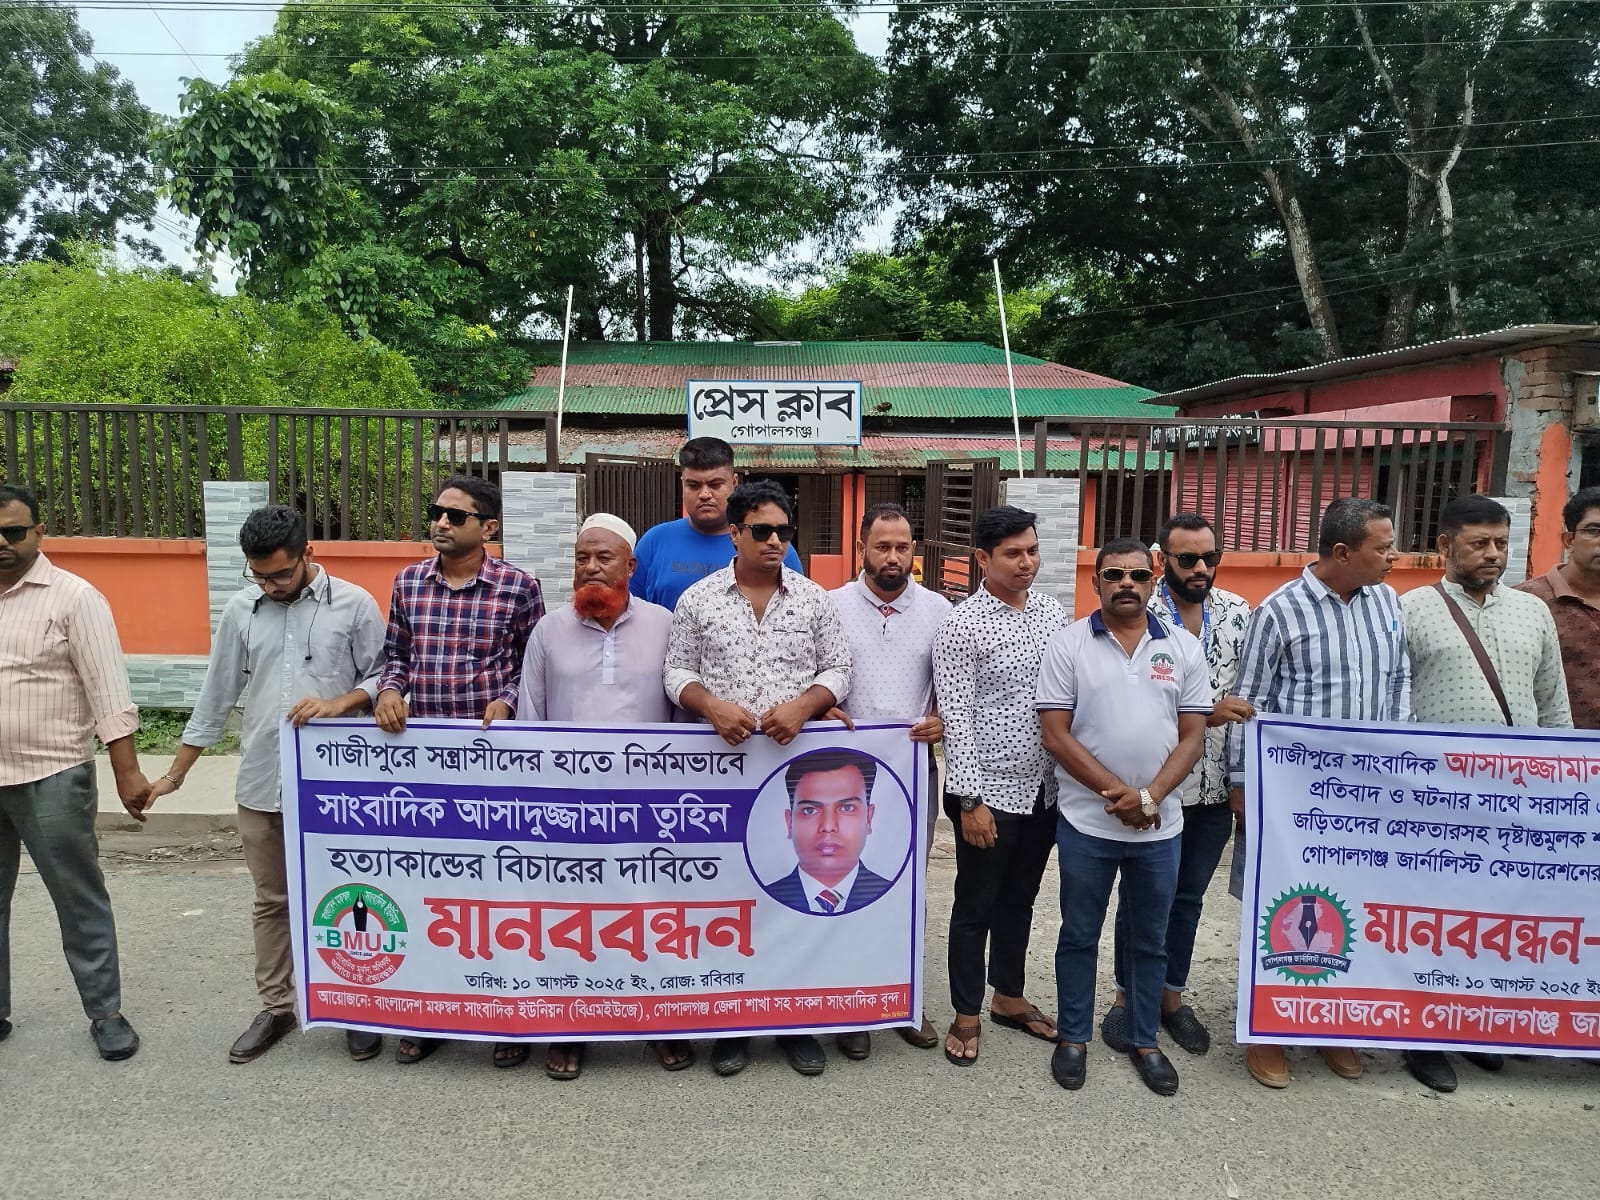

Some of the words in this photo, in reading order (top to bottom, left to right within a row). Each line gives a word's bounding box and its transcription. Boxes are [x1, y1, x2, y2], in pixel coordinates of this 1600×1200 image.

[694, 385, 768, 421] প্রেস
[775, 386, 856, 422] ক্লাব
[731, 423, 819, 438] গোপালগঞ্জ।
[316, 735, 419, 774] গাজীপুরে
[424, 738, 544, 773] সন্ত্রাসীদের
[550, 748, 616, 776] হাতে
[621, 742, 748, 776] নির্মমভাবে
[1267, 742, 1346, 772] গাজীপুরে
[1351, 751, 1438, 776] সাংবাদিক
[1443, 751, 1600, 788] আসাদুজ্জামা
[315, 786, 447, 828] সাংবাদিক
[452, 797, 642, 840] আসাদুজ্জামান
[648, 793, 731, 842] তুহিন
[1310, 776, 1382, 804] প্রতিবাদ
[1390, 788, 1404, 804] ও
[1412, 784, 1472, 810] ঘটনার
[1478, 793, 1522, 814] সাথে
[1528, 792, 1591, 816] সরাসরি
[1292, 807, 1382, 836] জড়িতদের
[1386, 819, 1491, 846] গ্রেফতারসহ
[1496, 822, 1587, 854] দৃষ্টান্তমুলক
[494, 846, 606, 884] বিচারের
[614, 846, 722, 884] দাবিতে
[1302, 844, 1389, 868] গোপালগঞ্জ
[1395, 848, 1484, 875] জার্নালিস্ট
[326, 929, 396, 952] BMUJ
[424, 897, 756, 962] মানববন্ধন
[512, 980, 530, 990] ১০
[535, 974, 580, 990] আগস্ট
[584, 976, 625, 990] ২০২৫
[700, 970, 744, 987] রবিবার
[1465, 976, 1484, 989] ১০
[1490, 976, 1536, 992] আগস্ট
[1540, 980, 1582, 996] ২০২৫
[374, 994, 422, 1016] বাংলাদেশ
[425, 999, 461, 1016] মফস্বল
[464, 998, 514, 1018] সাংবাদিক
[518, 999, 564, 1020] ইউনিয়ন
[654, 1000, 710, 1018] গোপালগঞ্জ
[714, 998, 741, 1015] জেলা
[746, 996, 770, 1014] শাখা
[774, 997, 792, 1013] সহ
[795, 995, 822, 1010] সকল
[826, 990, 878, 1008] সাংবাদিক
[1271, 995, 1411, 1026] আয়োজনে:
[1422, 1002, 1560, 1037] গোপালগঞ্জ
